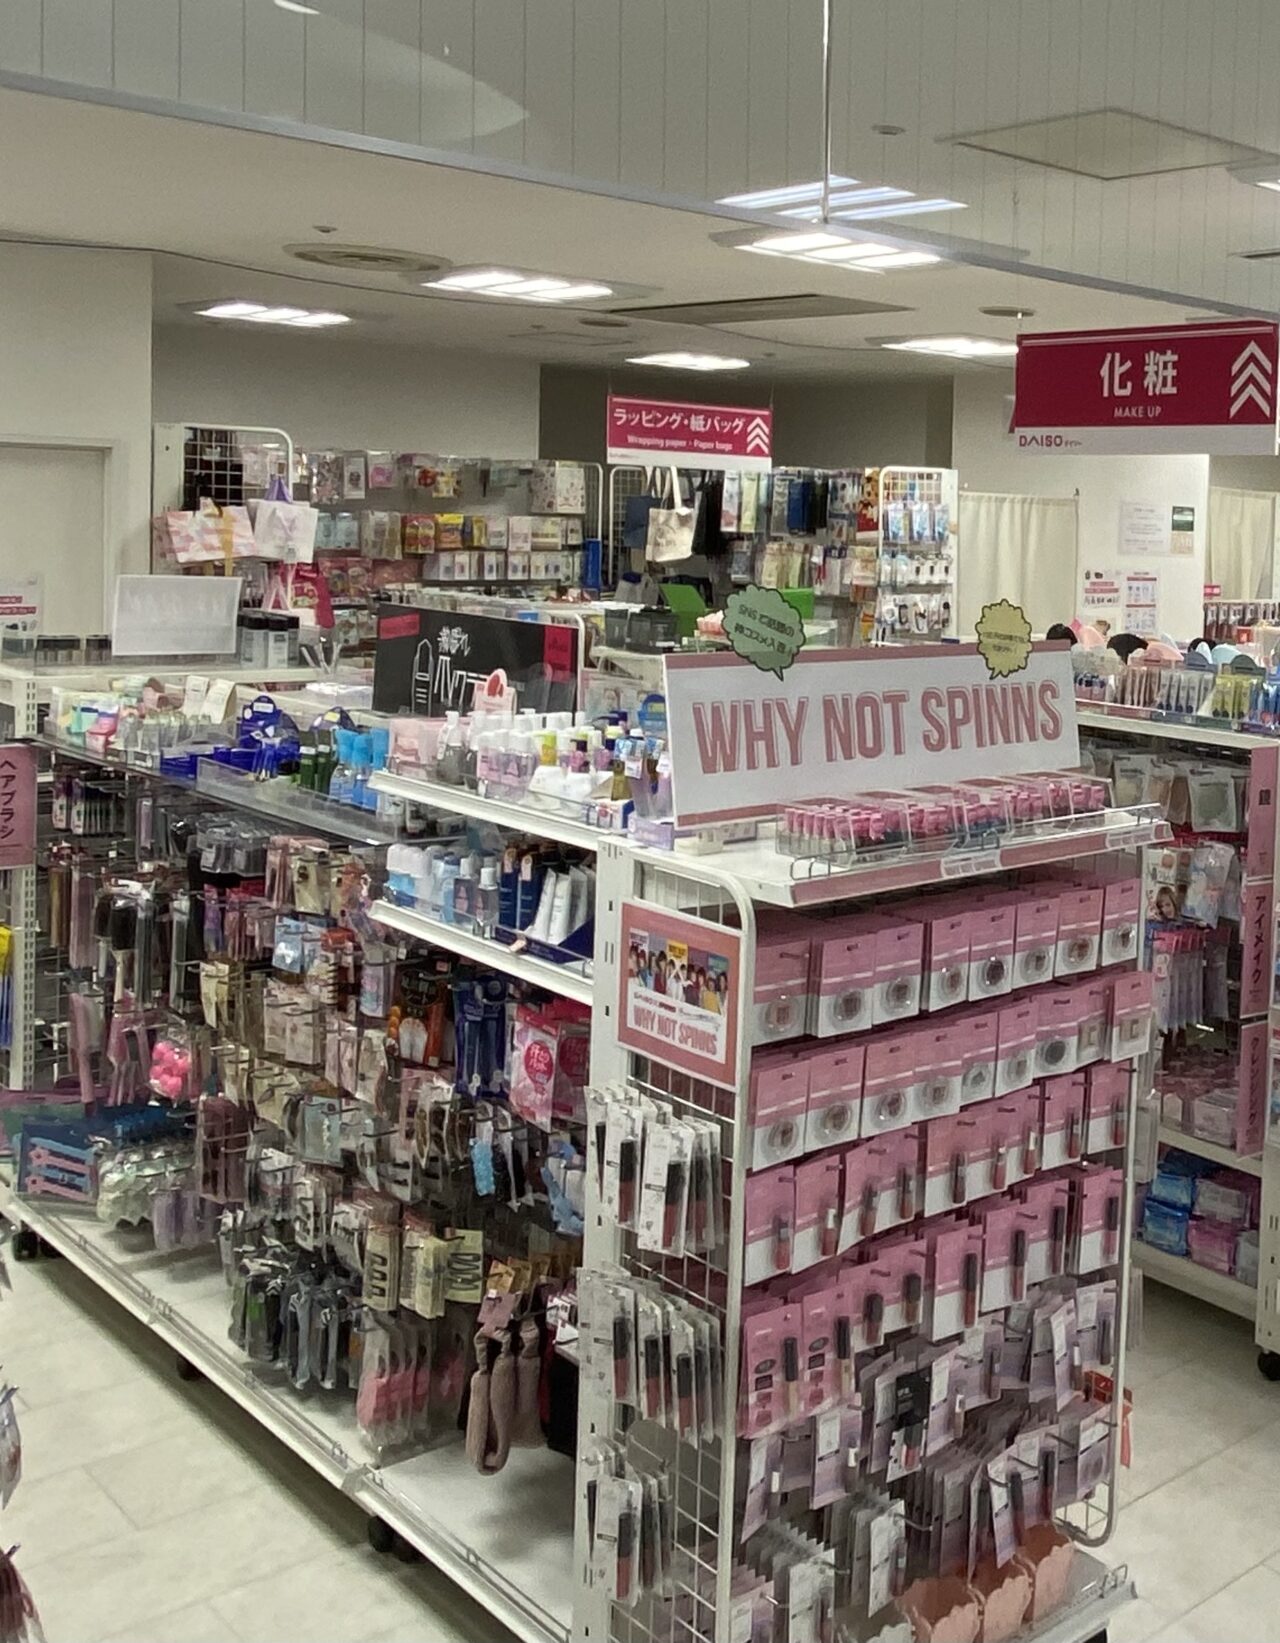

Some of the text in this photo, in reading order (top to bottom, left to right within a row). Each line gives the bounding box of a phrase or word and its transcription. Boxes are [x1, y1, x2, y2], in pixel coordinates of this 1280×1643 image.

[1100, 350, 1178, 397] 化粧
[613, 408, 746, 434] ラッピング・紙バッグ
[1114, 406, 1162, 418] MAKE UP
[1019, 434, 1063, 447] DAISO
[692, 679, 1064, 775] WHY NOT SPINNS
[1252, 895, 1268, 985] アイメイク
[634, 1005, 656, 1032] WHY
[657, 1015, 678, 1042] NOT
[679, 1022, 717, 1056] SPINNS
